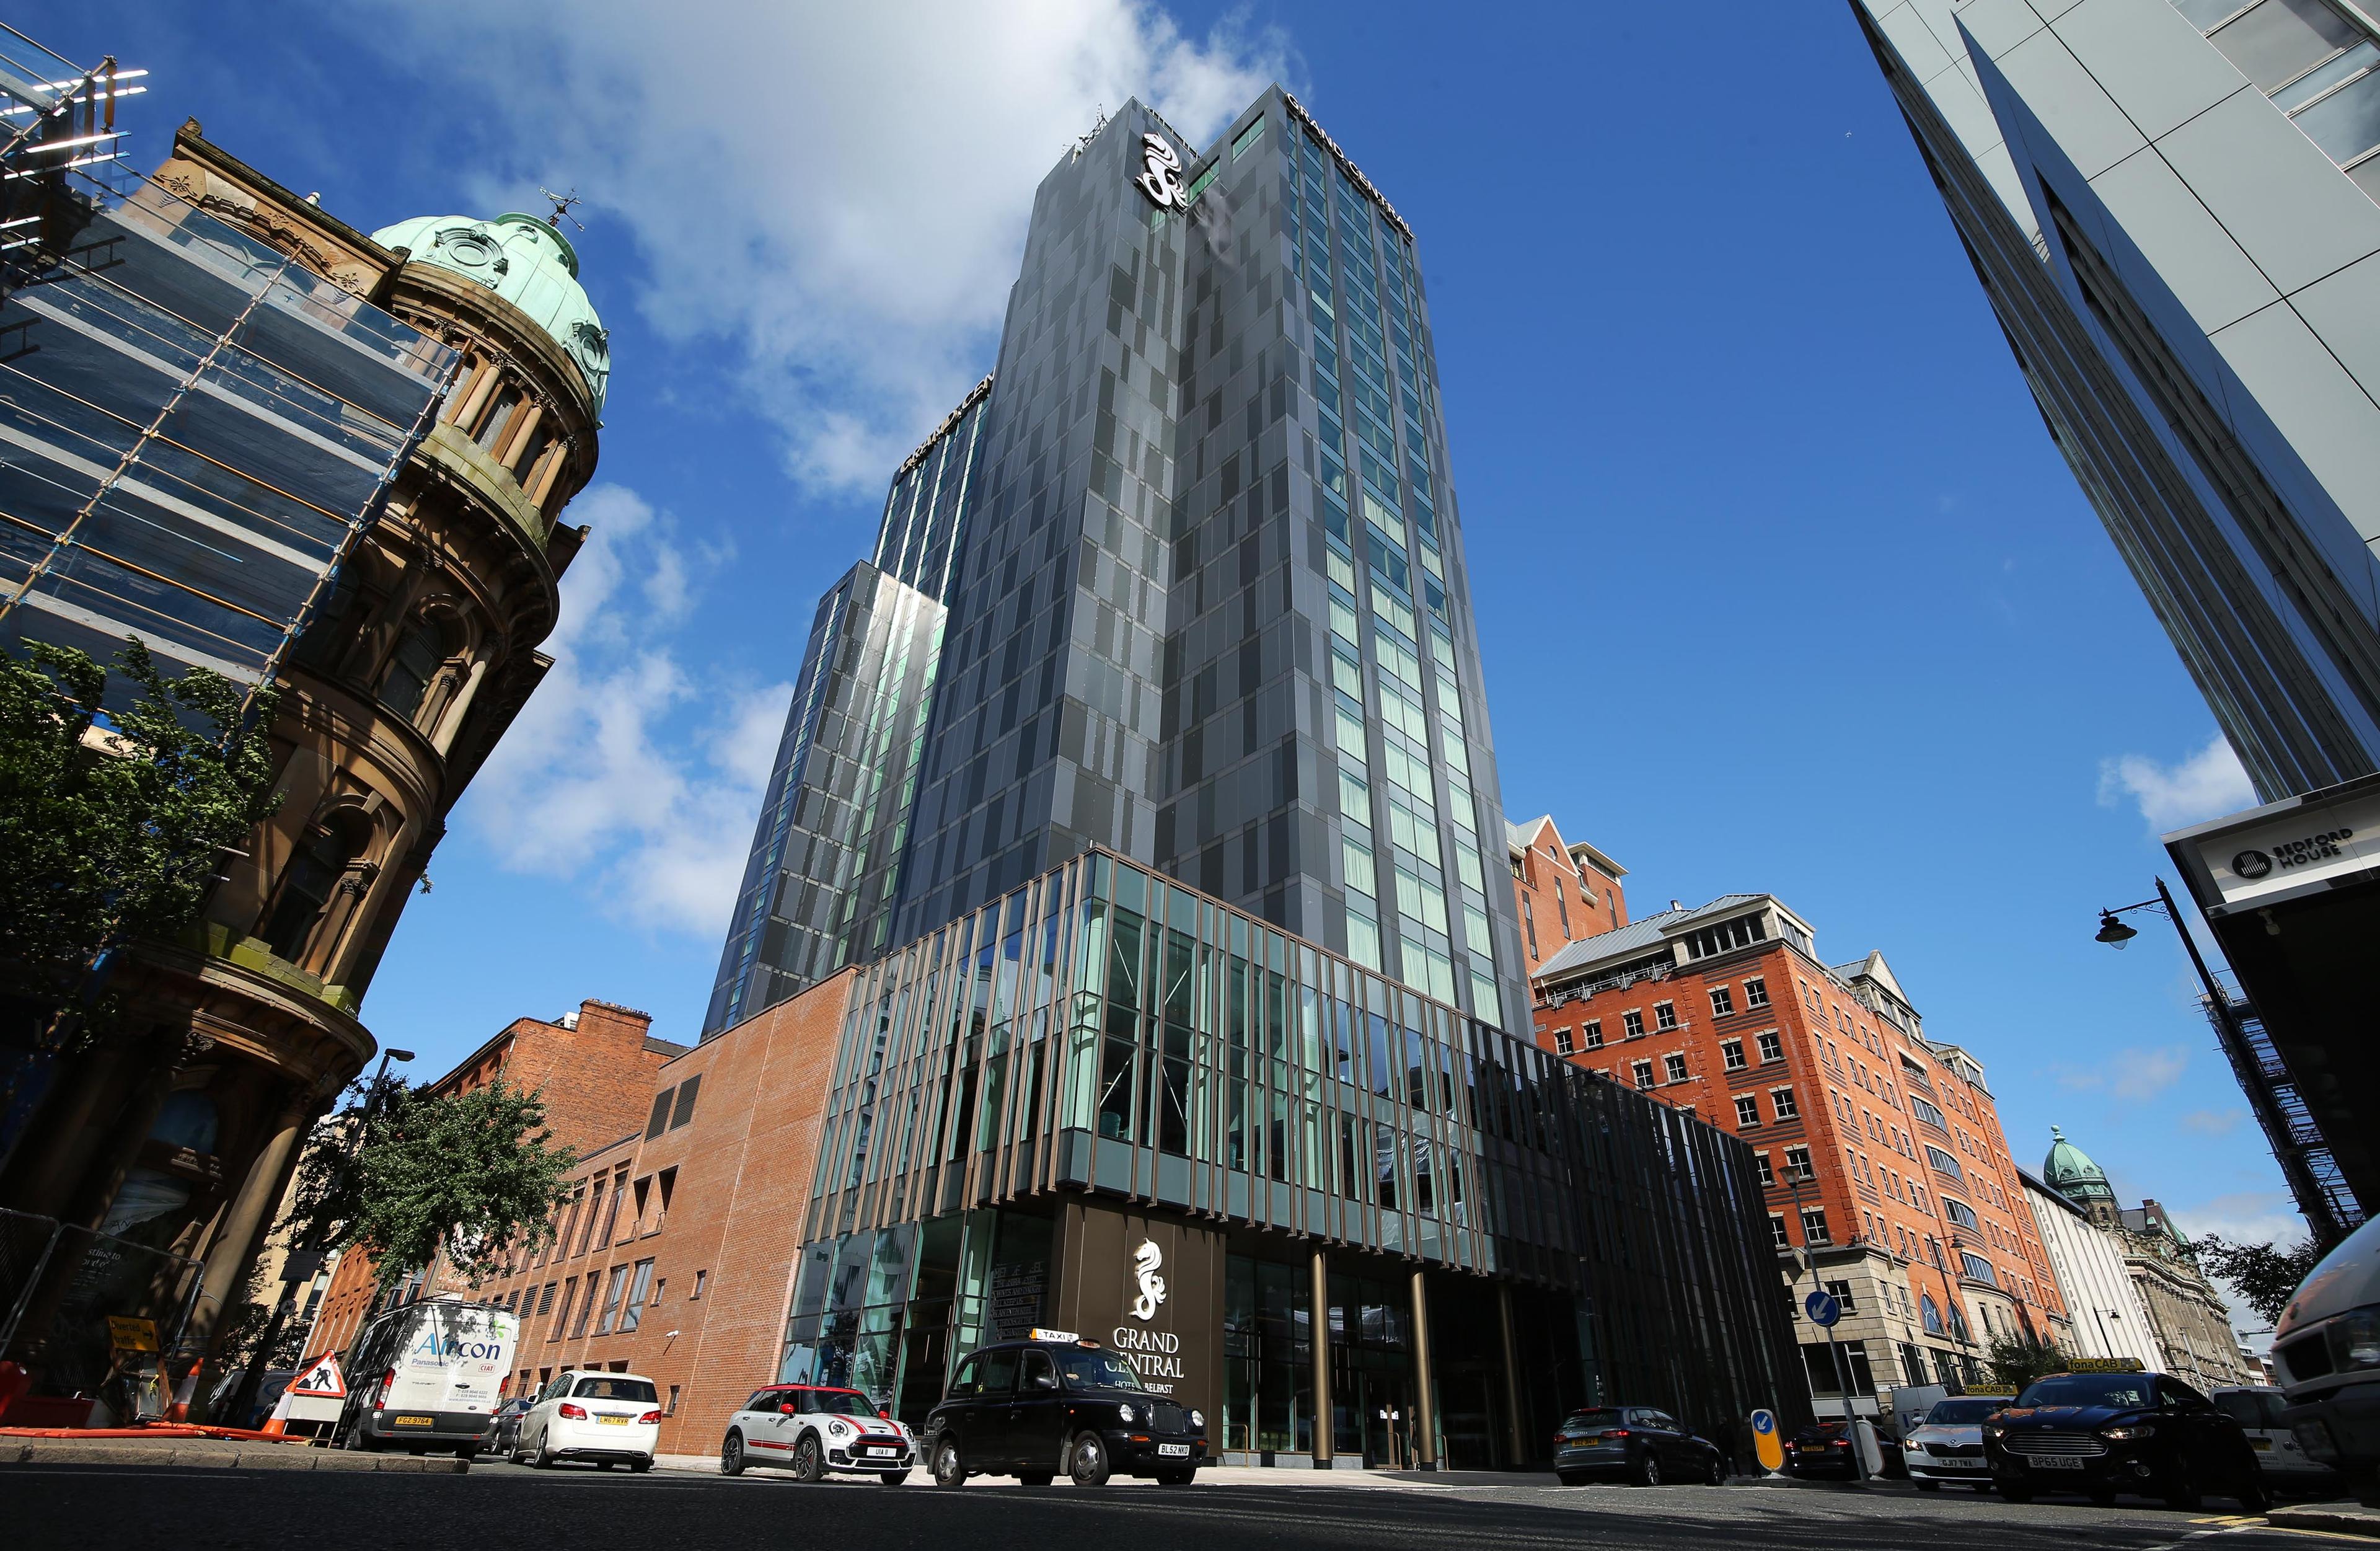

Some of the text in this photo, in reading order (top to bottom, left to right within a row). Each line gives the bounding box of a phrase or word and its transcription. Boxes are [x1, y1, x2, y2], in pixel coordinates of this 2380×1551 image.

[1286, 93, 1415, 239] GRAND CENTRAL
[900, 409, 958, 474] GRAND
[2272, 828, 2353, 858] BEDFORD
[2280, 845, 2342, 869] HOUSE
[110, 1321, 140, 1331] Diverted
[114, 1335, 136, 1345] traffic
[1043, 1331, 1065, 1340] TAXI
[1113, 1327, 1179, 1354] GRAND
[416, 1333, 501, 1360] Aircon
[2069, 1359, 2118, 1370] fonaCAB
[1145, 1382, 1174, 1394] BELFAST
[1967, 1385, 2001, 1394] fonaCAB
[1161, 1445, 1178, 1454] BL52
[2032, 1456, 2081, 1468] BP65 UGE
